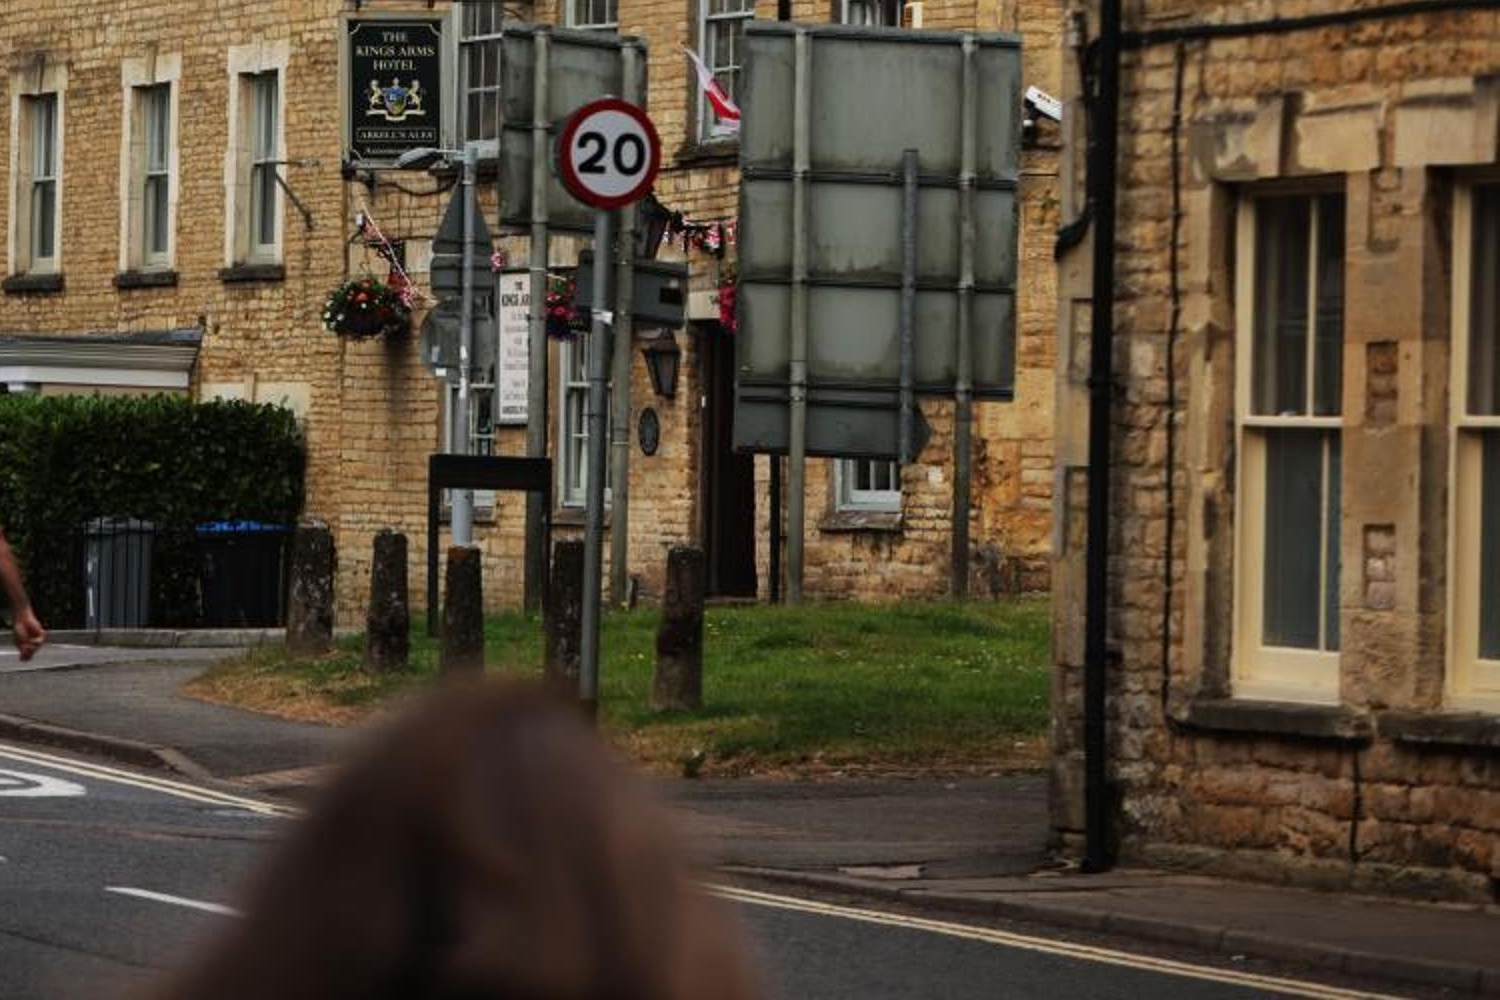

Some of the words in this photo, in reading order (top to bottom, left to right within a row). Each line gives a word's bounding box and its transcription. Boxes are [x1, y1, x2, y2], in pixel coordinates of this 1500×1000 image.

[381, 31, 408, 42] THE
[355, 45, 396, 57] KINGS
[399, 45, 436, 57] ARMS
[373, 59, 417, 71] HOTEL
[577, 131, 646, 176] 20
